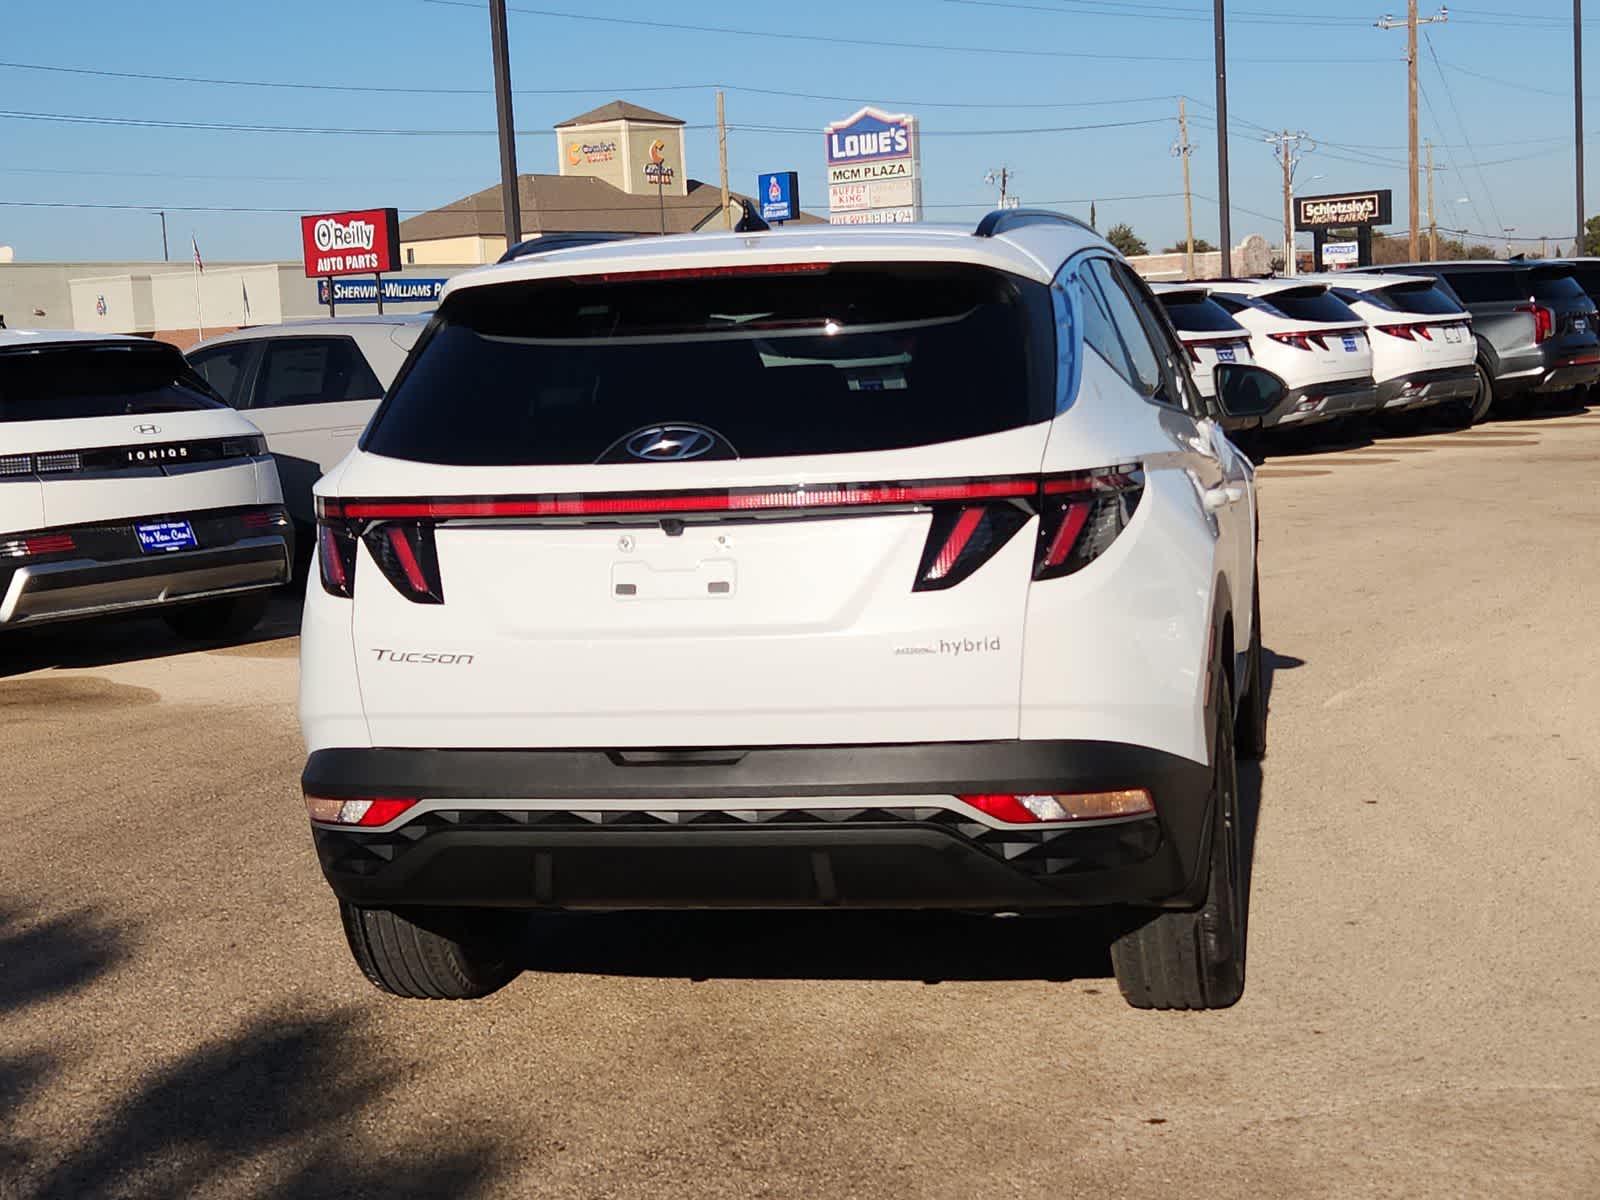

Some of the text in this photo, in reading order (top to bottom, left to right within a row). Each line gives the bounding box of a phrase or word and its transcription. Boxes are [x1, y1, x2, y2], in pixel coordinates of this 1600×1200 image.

[832, 128, 907, 158] LOWE'S
[832, 163, 906, 180] MCM PLAZA
[315, 220, 374, 250] O'Reilly
[317, 253, 378, 272] AUTO PARTS
[939, 636, 1000, 656] hybrid
